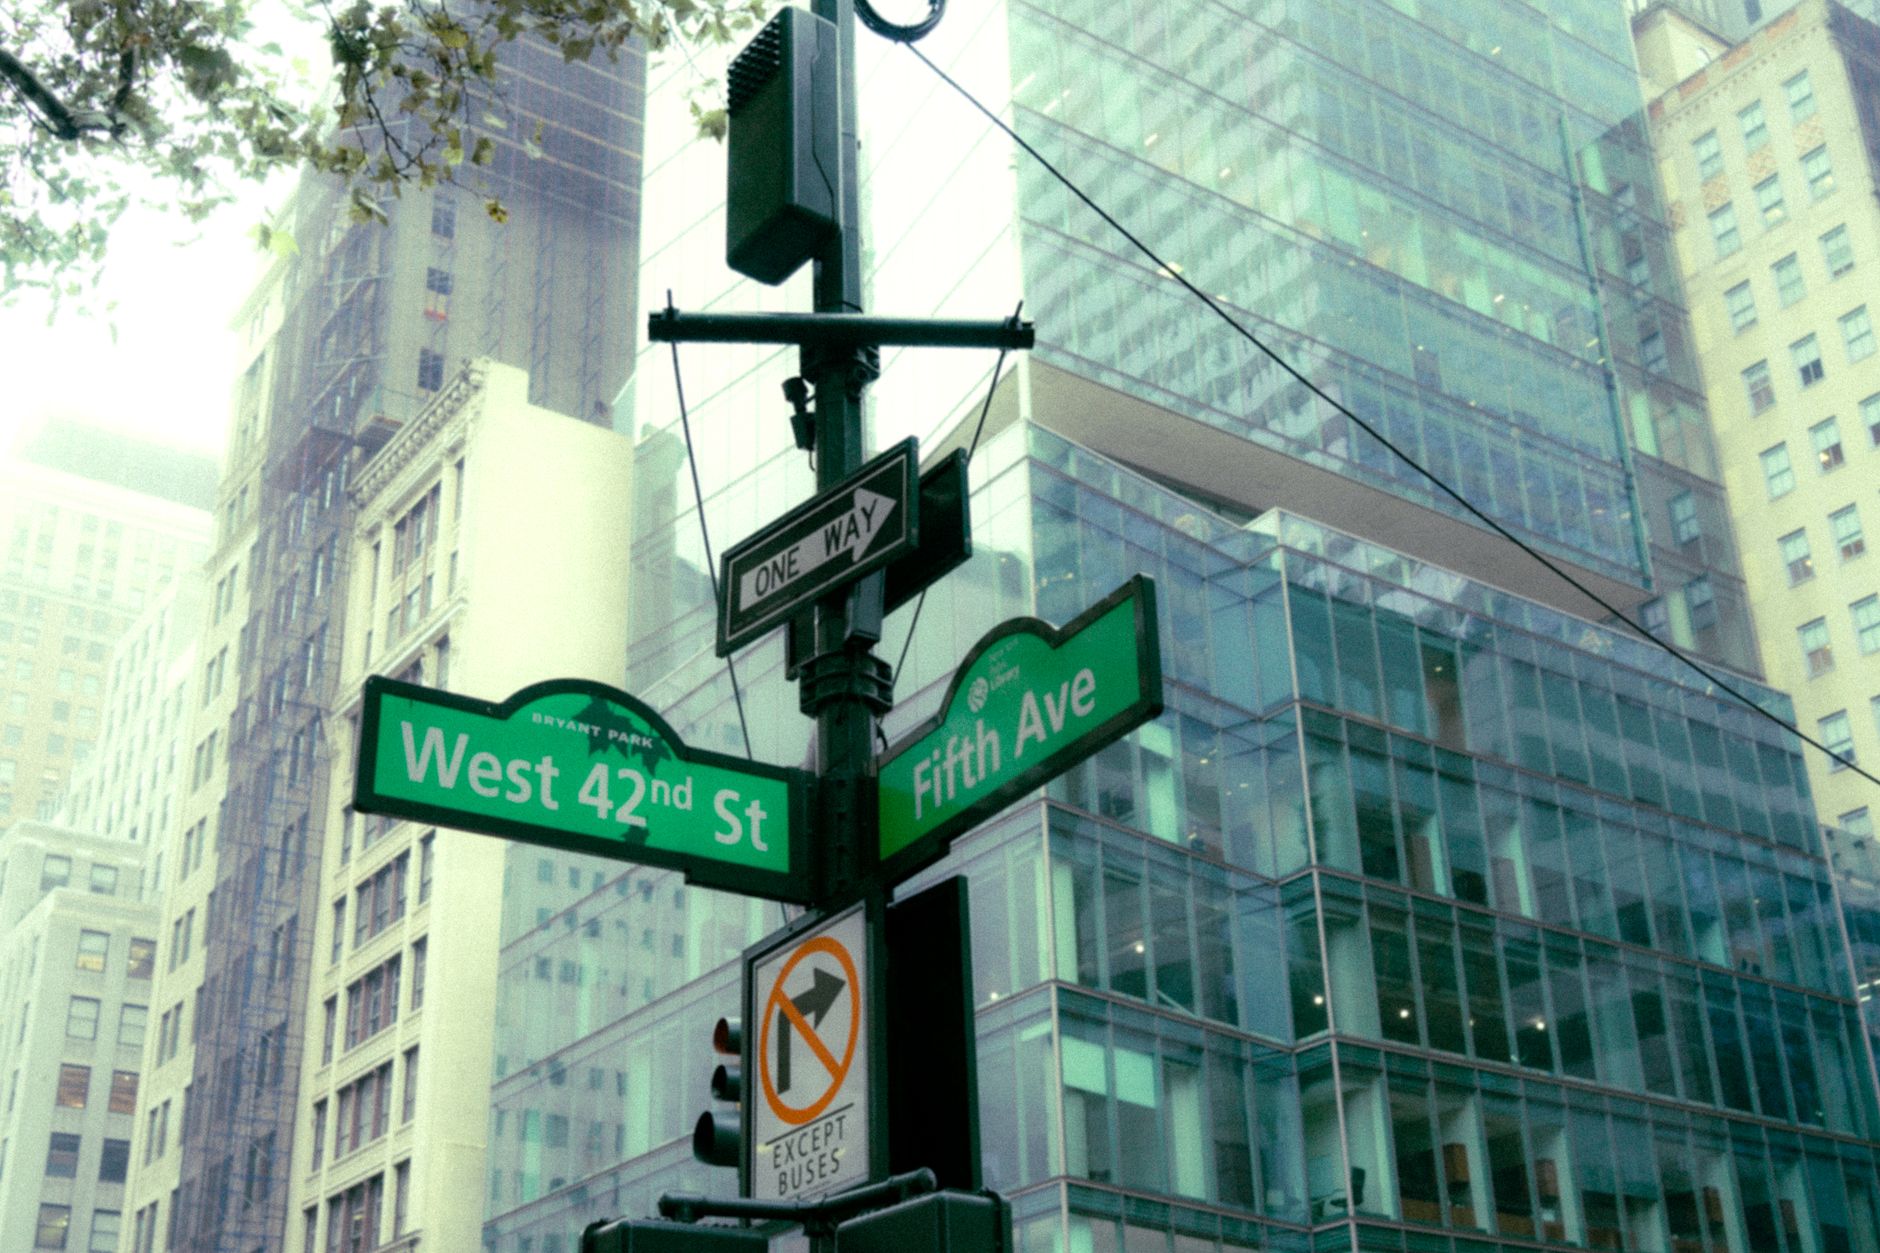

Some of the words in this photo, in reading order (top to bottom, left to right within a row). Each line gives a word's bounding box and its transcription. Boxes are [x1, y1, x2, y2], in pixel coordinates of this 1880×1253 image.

[756, 547, 799, 597] ONE
[824, 499, 878, 556] WAY
[532, 712, 601, 737] BRYANT
[608, 729, 654, 749] PARK
[914, 719, 1000, 820] Fifth
[1014, 668, 1096, 759] Ave
[401, 720, 559, 810] West
[578, 763, 693, 827] 42nd
[714, 788, 768, 851] St
[774, 1116, 846, 1169] EXCEPT
[779, 1148, 840, 1196] BUSES
